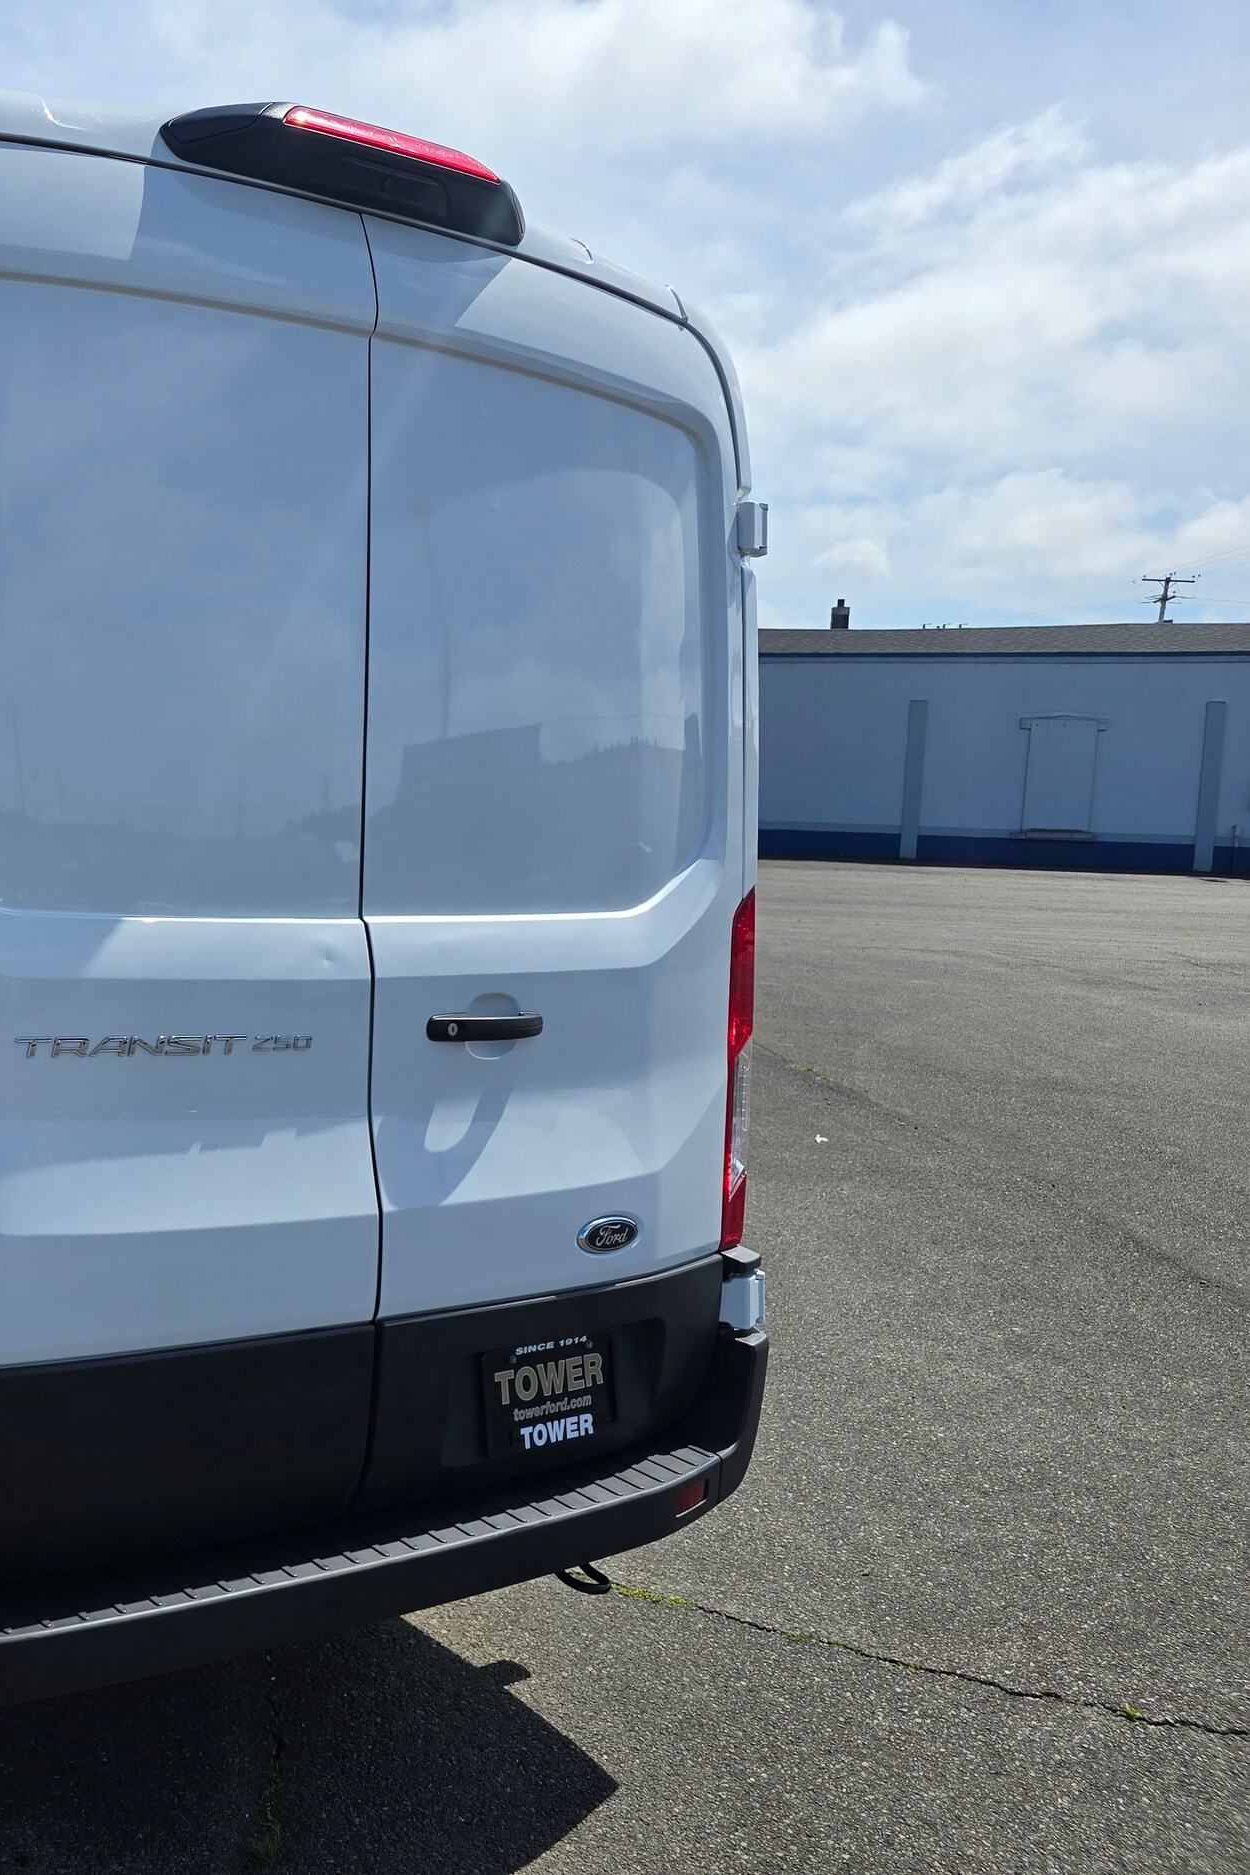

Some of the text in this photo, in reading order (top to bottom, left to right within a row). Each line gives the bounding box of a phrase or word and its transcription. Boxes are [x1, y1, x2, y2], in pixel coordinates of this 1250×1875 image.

[15, 1033, 313, 1058] TRANSIT 250
[595, 1224, 628, 1247] Ford
[515, 1335, 588, 1356] SINCE 1914
[494, 1352, 604, 1405] TOWER
[513, 1395, 592, 1421] towerford.com
[520, 1413, 594, 1449] TOWER
